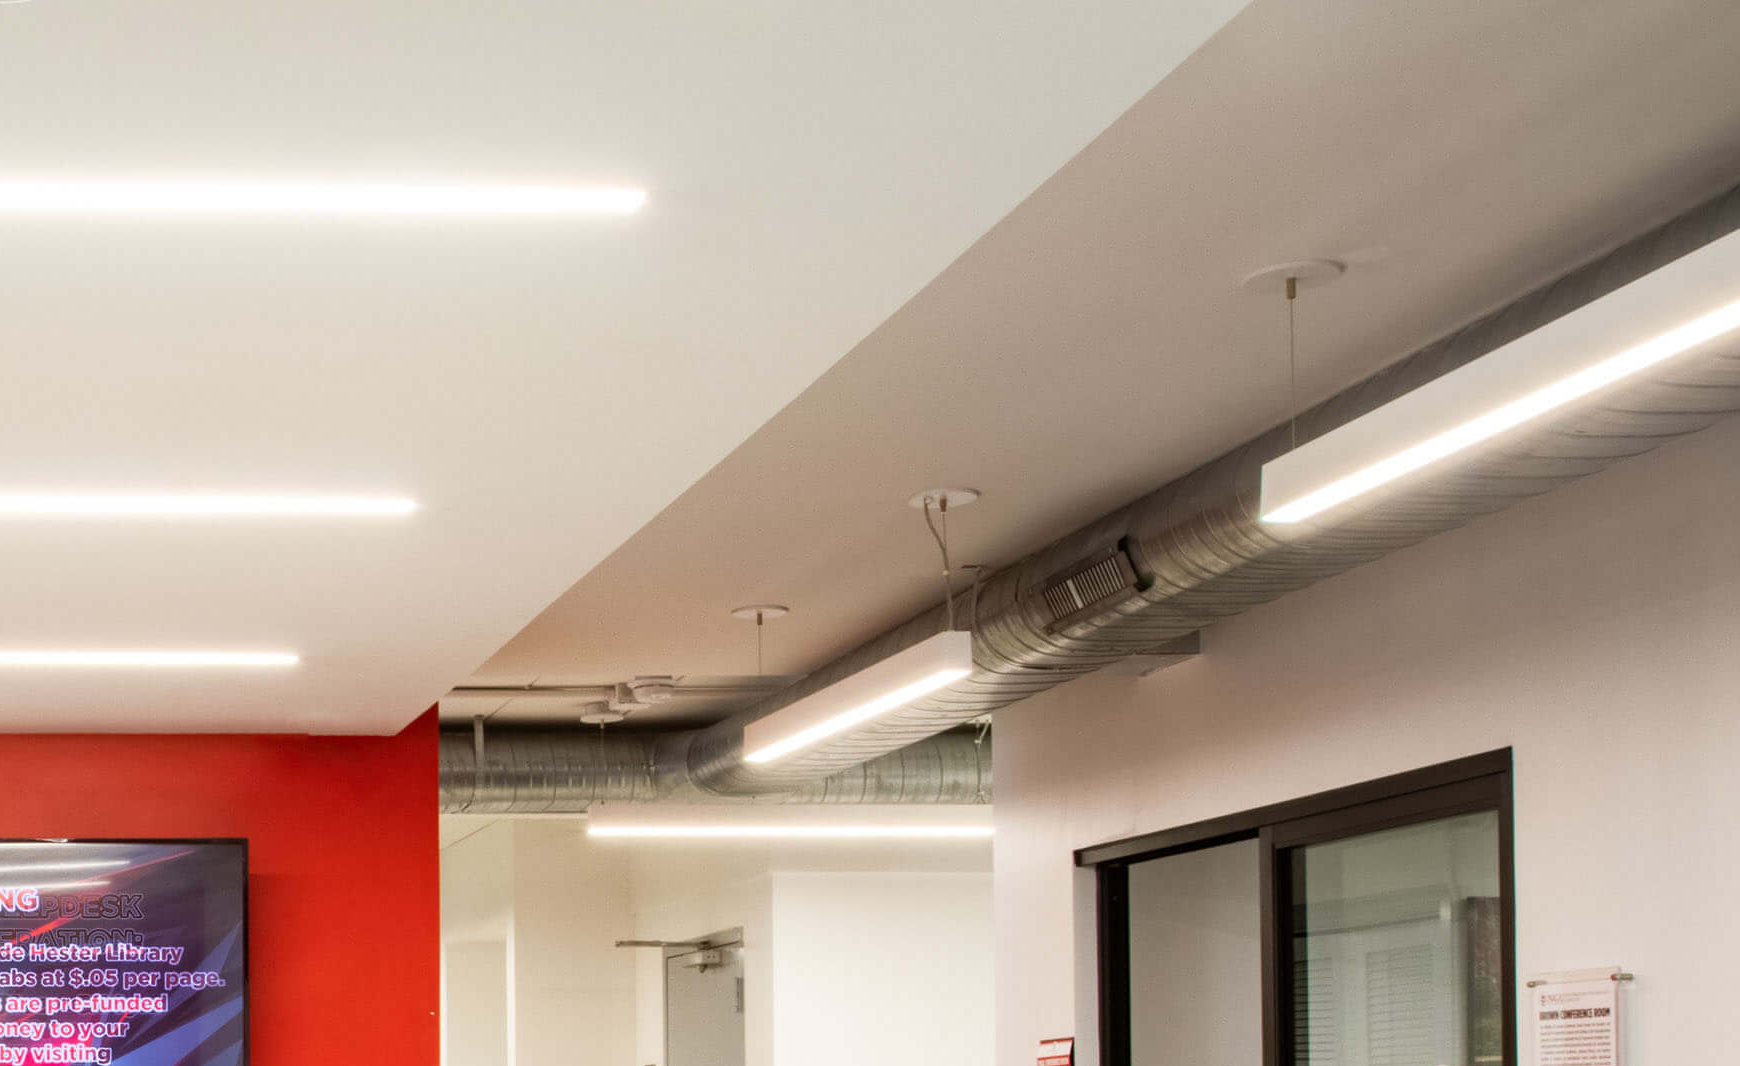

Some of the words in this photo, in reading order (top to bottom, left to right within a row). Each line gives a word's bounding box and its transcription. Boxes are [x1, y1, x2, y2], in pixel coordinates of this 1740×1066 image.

[30, 943, 101, 962] Hester
[106, 943, 184, 965] Library
[41, 969, 64, 987] at
[69, 968, 118, 988] $.05
[123, 971, 160, 989] per
[164, 971, 226, 990] page.
[5, 997, 43, 1013] are
[47, 994, 168, 1015] pre-funded
[50, 1020, 74, 1038] to
[78, 1022, 129, 1040] your
[0, 1044, 28, 1066] by
[30, 1044, 112, 1066] visiting
